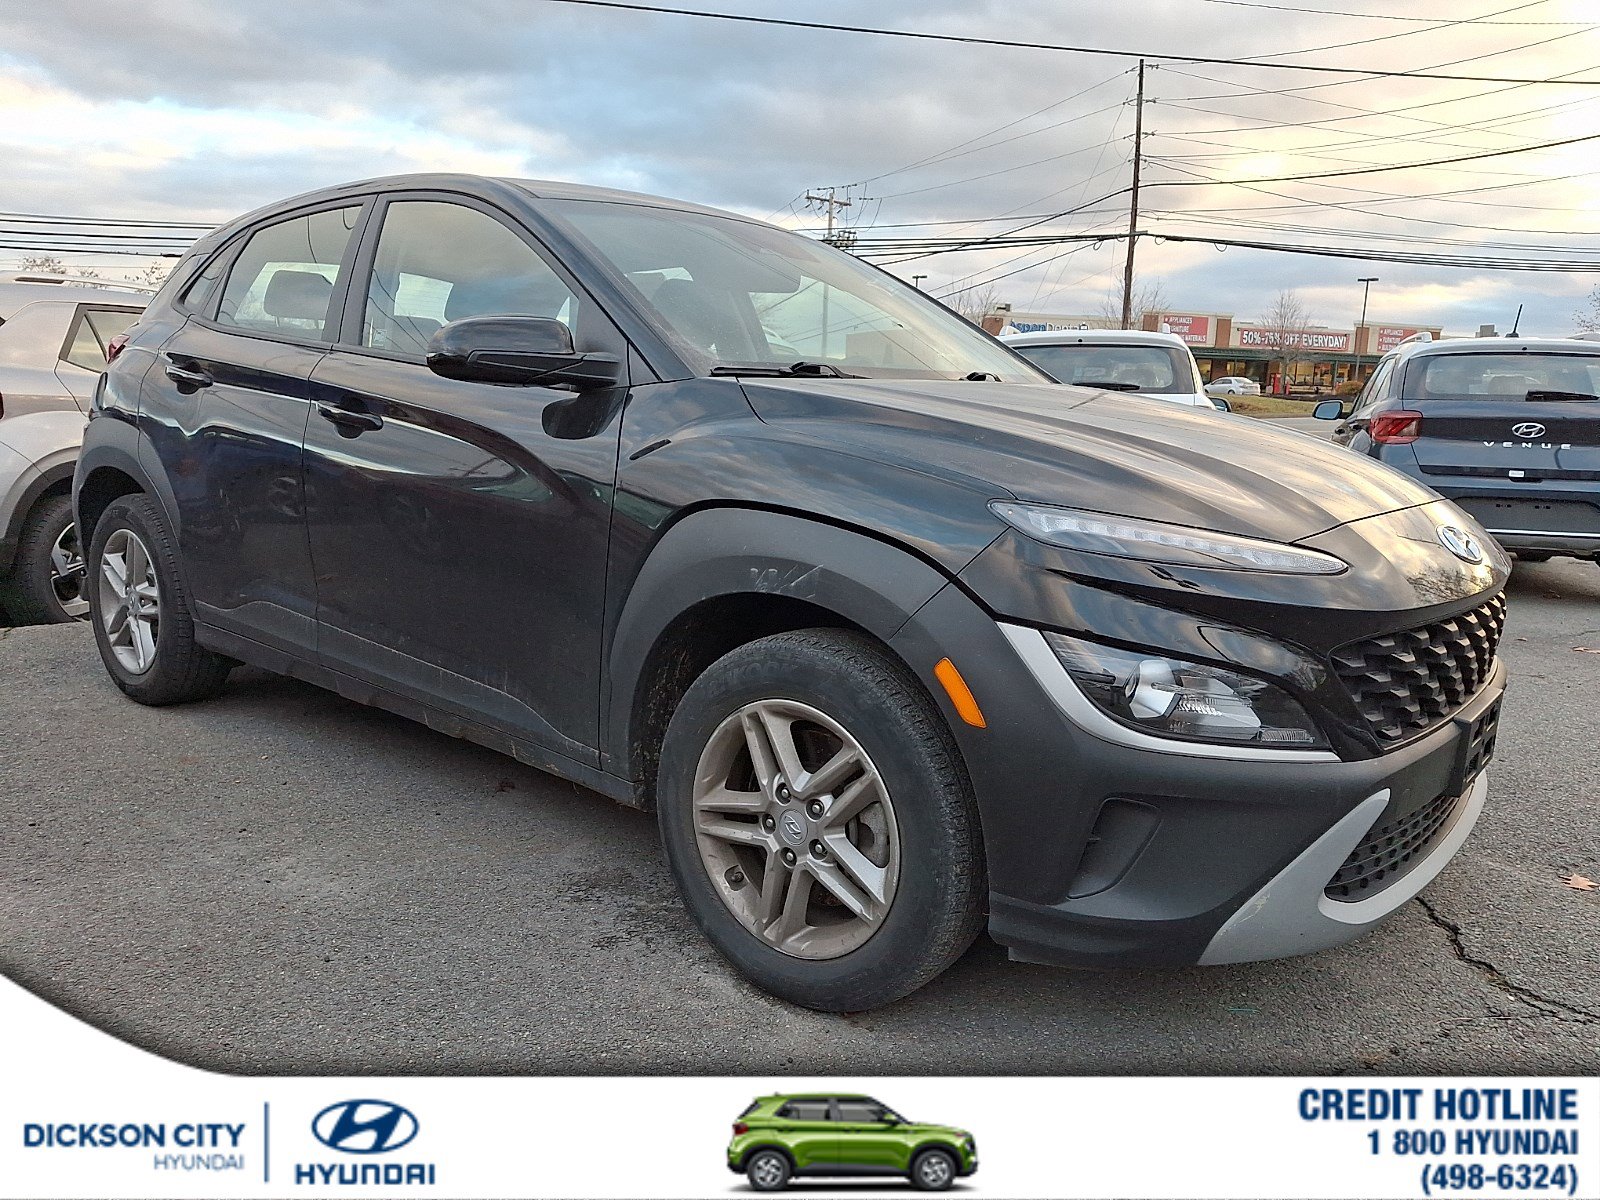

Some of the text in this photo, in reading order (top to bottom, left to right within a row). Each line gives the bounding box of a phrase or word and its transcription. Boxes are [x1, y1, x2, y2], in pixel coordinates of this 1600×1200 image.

[1170, 325, 1189, 333] URNITURE
[1284, 333, 1300, 346] OFF
[1302, 333, 1346, 349] EVERYDAY!
[1483, 441, 1571, 449] VENUE
